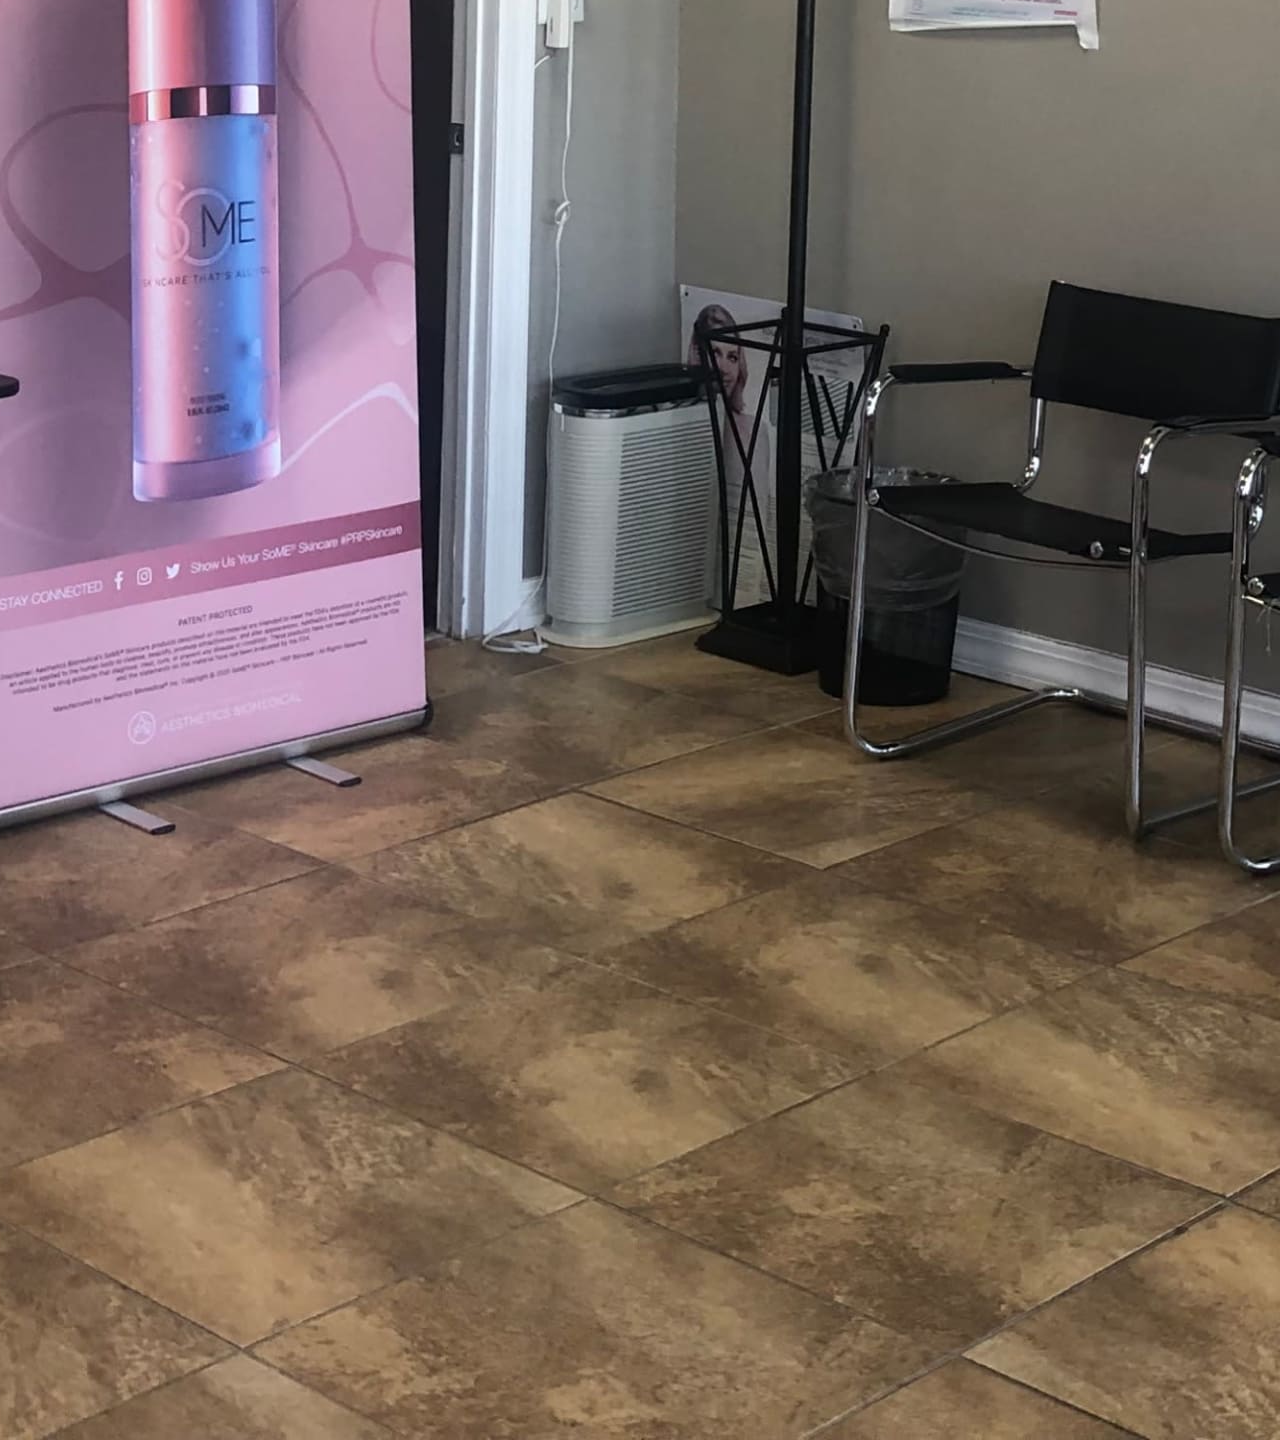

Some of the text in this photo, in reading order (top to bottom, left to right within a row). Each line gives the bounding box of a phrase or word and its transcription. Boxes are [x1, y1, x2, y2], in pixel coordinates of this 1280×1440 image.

[143, 275, 188, 288] SKNCARE
[193, 271, 232, 284] THAT'S
[0, 594, 29, 611] STAY
[31, 580, 104, 605] CONNECTED
[190, 561, 219, 574] Show
[221, 557, 236, 569] Us
[238, 552, 261, 565] Your
[298, 537, 339, 554] Skincare
[340, 525, 403, 545] #PRPSkincare
[178, 605, 254, 628] PATENT PROTECTED
